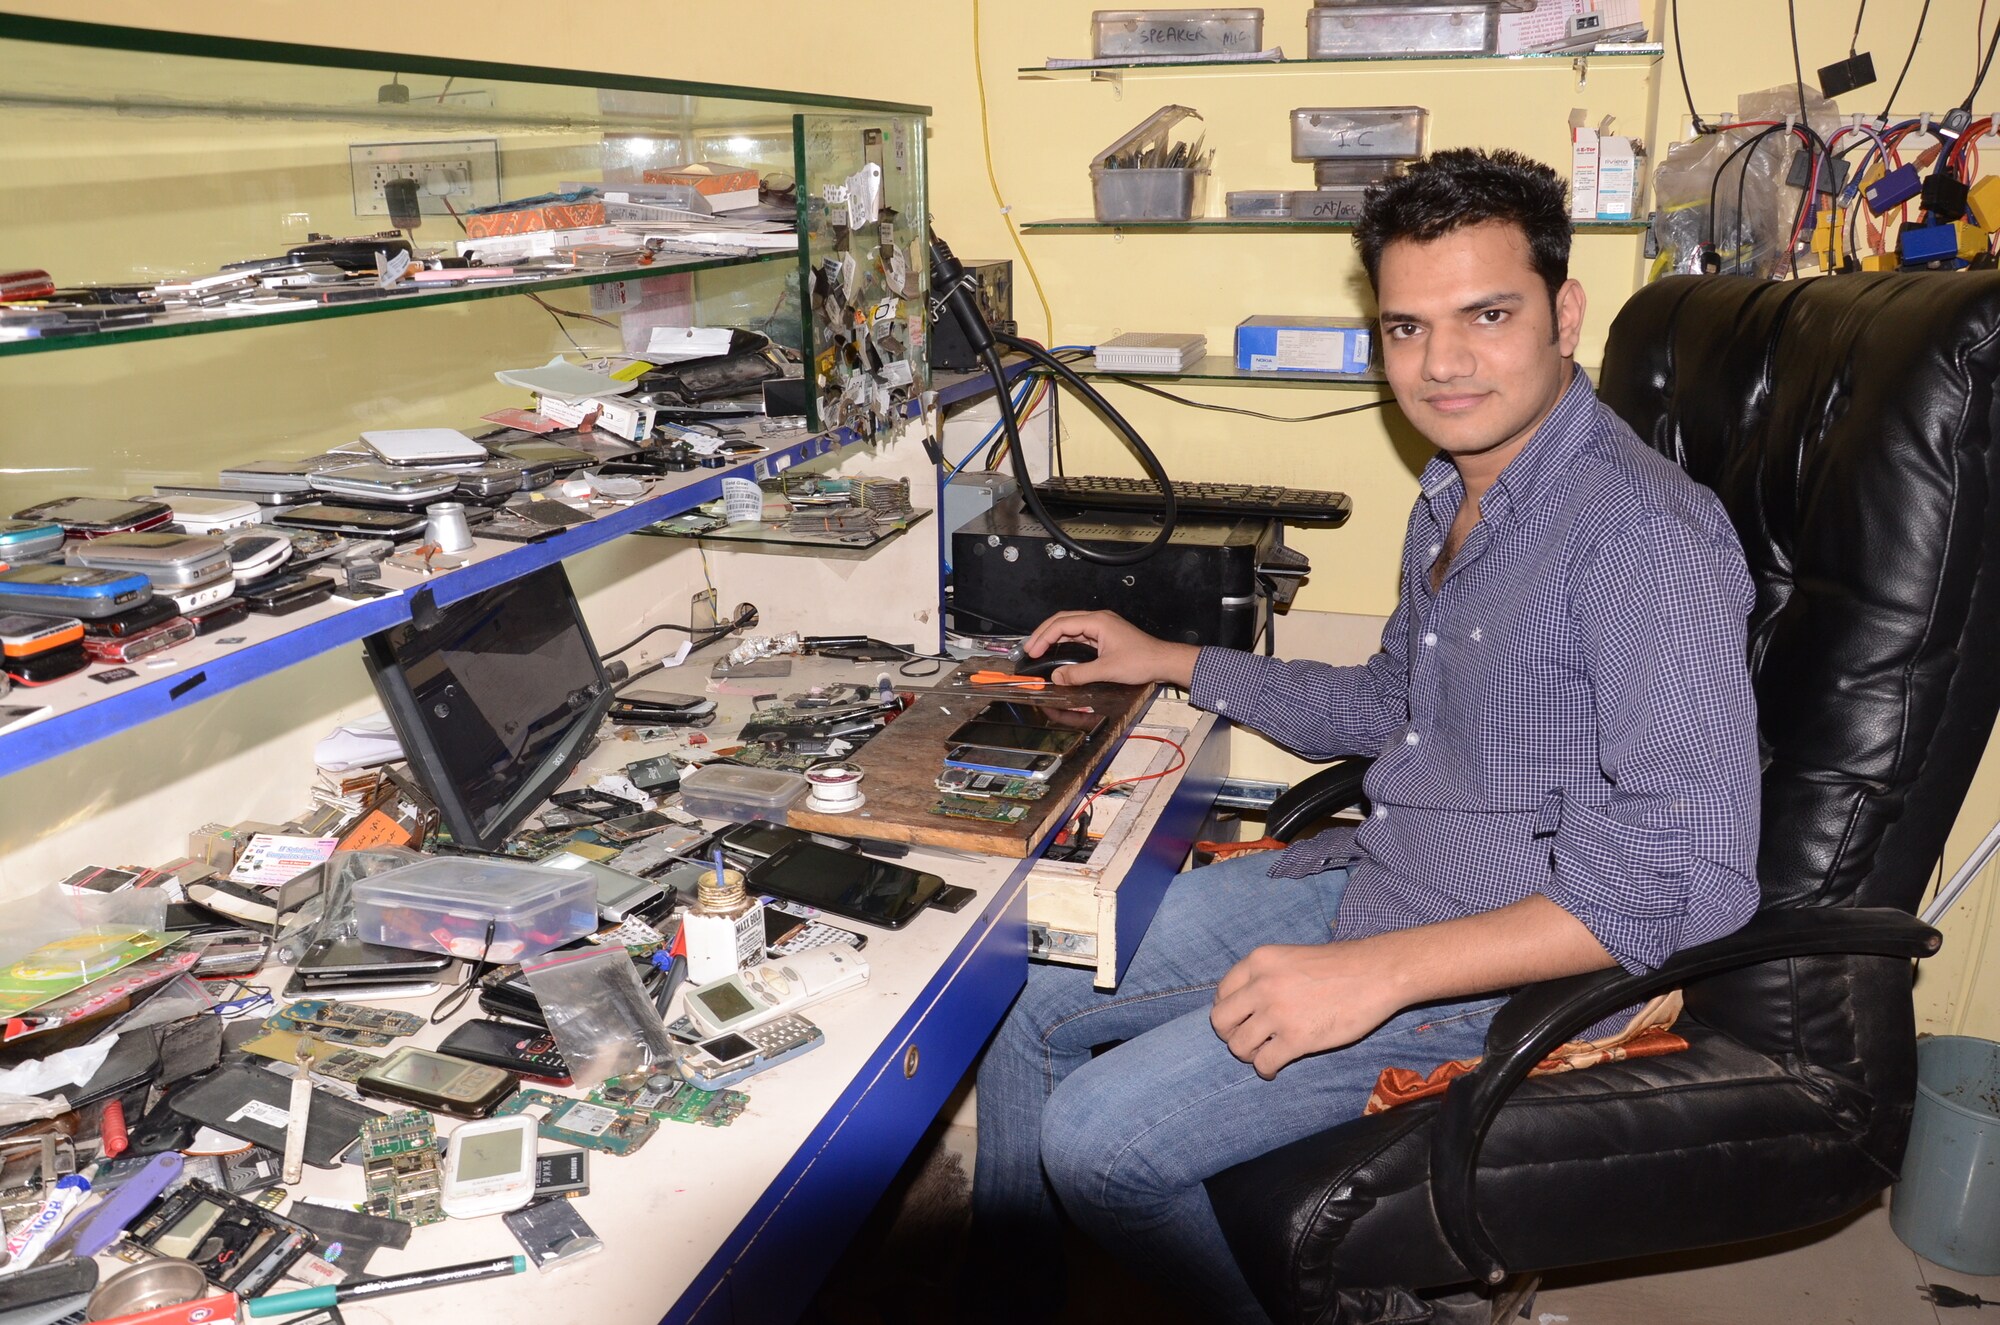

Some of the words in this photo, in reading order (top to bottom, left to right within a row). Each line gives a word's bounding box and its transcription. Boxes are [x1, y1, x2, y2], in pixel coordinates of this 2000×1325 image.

[1140, 26, 1207, 44] SPEAKER
[1222, 30, 1246, 46] MIC
[735, 919, 750, 934] MAXX
[750, 909, 762, 925] GOLD
[570, 1157, 578, 1180] SAMSUNG
